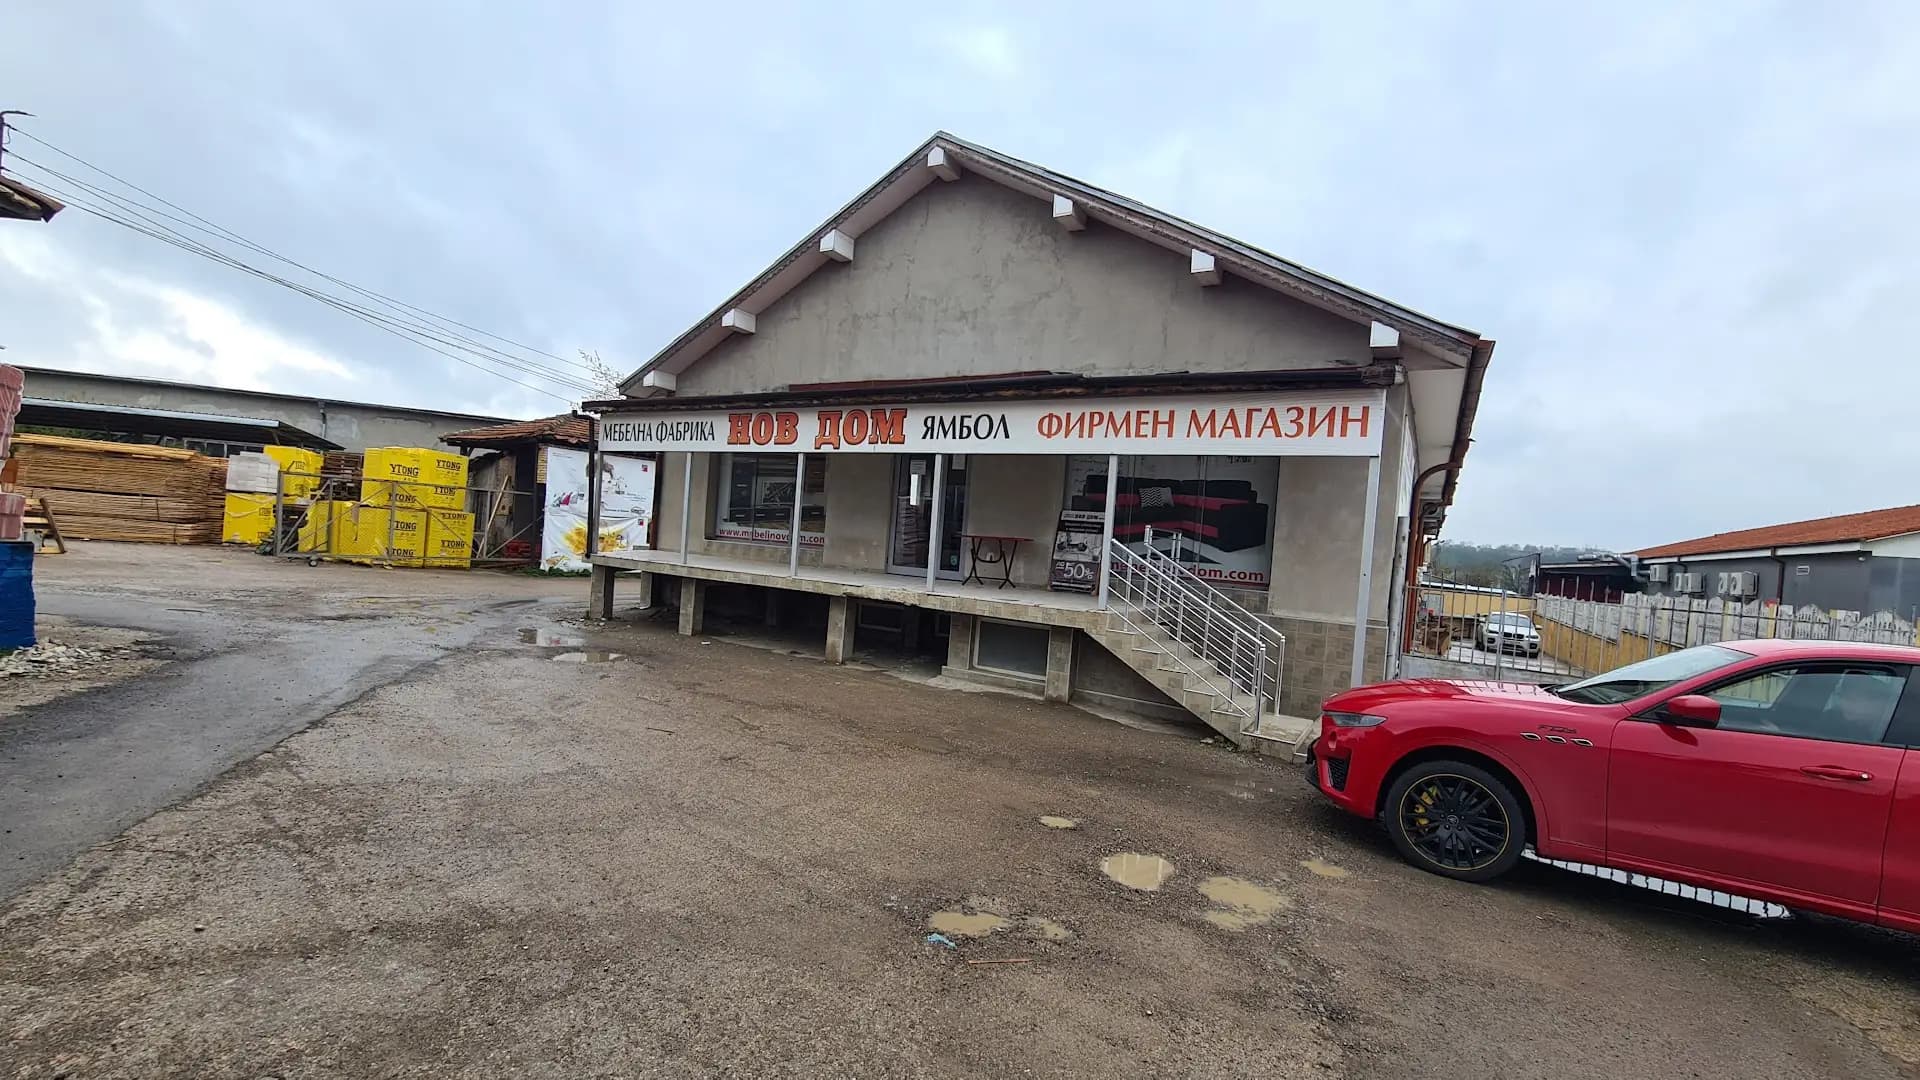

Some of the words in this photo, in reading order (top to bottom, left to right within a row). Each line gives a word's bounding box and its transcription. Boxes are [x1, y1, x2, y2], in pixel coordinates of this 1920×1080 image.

[602, 421, 652, 442] МЕБЕЛНА
[655, 420, 716, 444] ФАБРИКА
[727, 412, 799, 446] НОВ
[814, 408, 908, 450] ДОМ
[921, 413, 1010, 440] ЯМБОЛ
[1037, 409, 1175, 439] ФИРМЕН
[1186, 405, 1370, 438] МАГАЗИН
[390, 464, 419, 477] YTONG
[436, 459, 462, 471] YTONG
[392, 521, 417, 531] TONG
[1063, 562, 1094, 579] 50%
